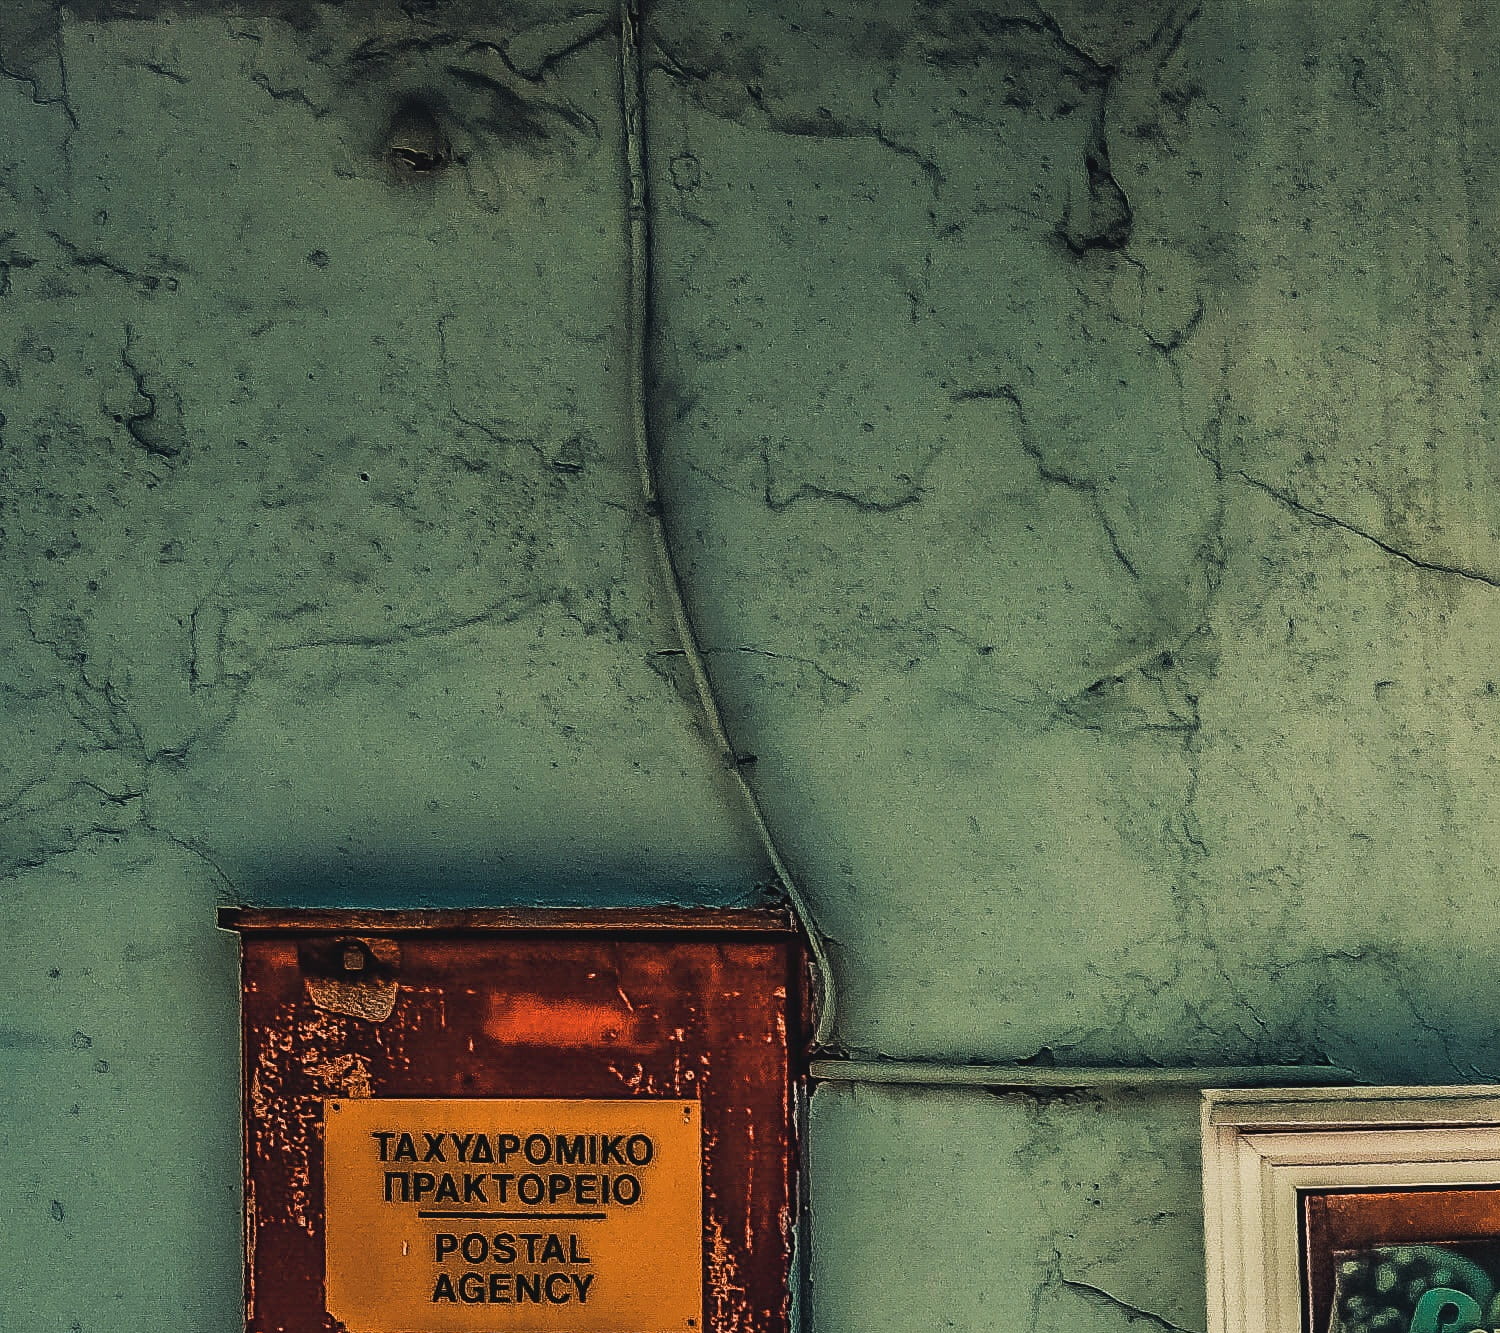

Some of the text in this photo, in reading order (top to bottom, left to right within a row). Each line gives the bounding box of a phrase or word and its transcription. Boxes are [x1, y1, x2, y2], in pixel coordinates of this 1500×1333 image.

[371, 1131, 654, 1166] ΤΑΧΥΔΡΟΜΙΚΟ
[383, 1171, 642, 1206] ΠΡΑΚΤΟΡΕΙΟ
[435, 1231, 592, 1265] POSTAL
[430, 1271, 595, 1305] AGENCY
